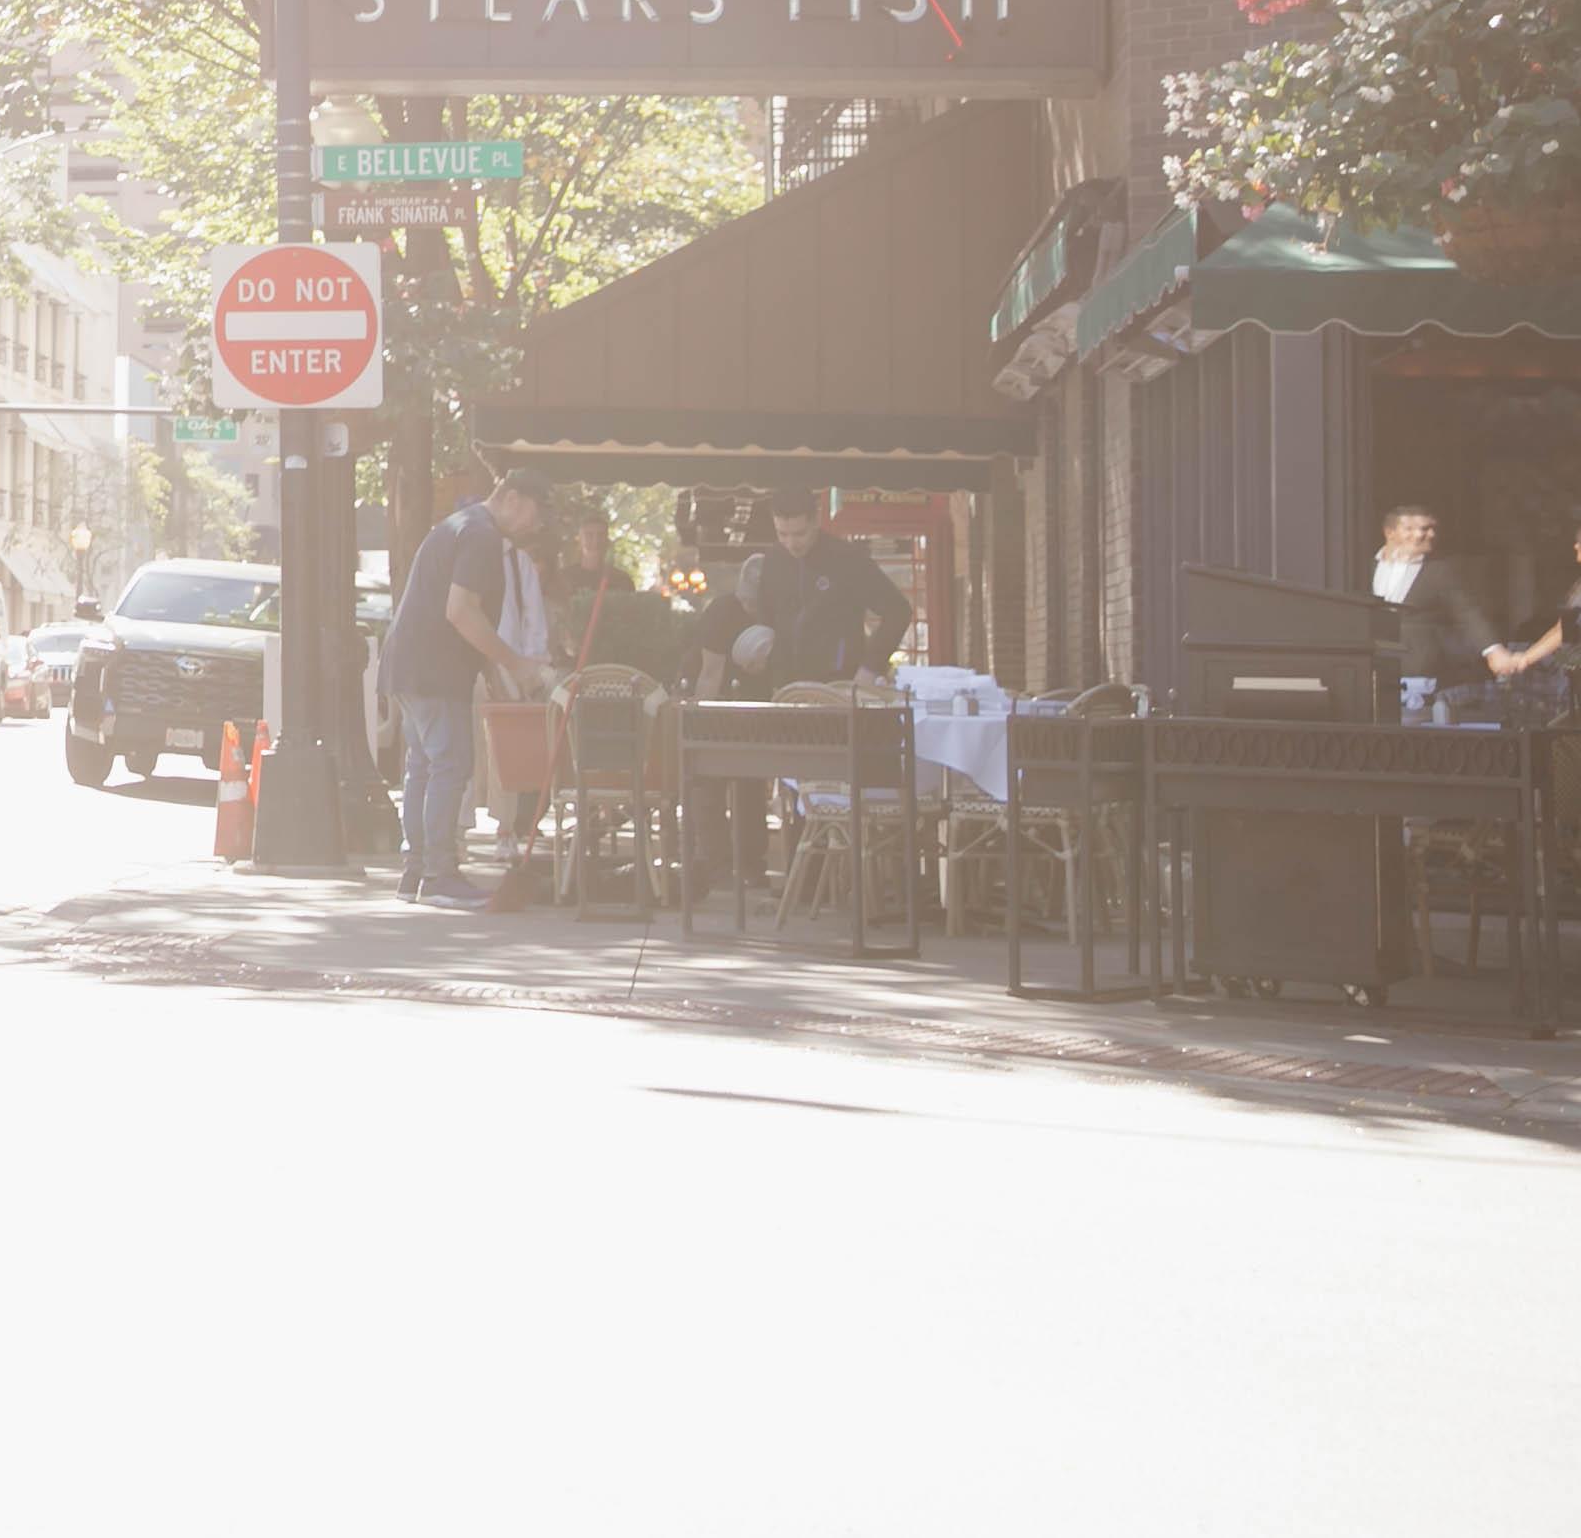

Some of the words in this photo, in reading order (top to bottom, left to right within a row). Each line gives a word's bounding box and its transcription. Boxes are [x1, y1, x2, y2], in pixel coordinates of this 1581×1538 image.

[337, 155, 348, 172] E
[356, 145, 483, 176] BELLEVUE
[374, 196, 429, 207] HONORARY
[337, 206, 385, 225] FRANK
[391, 204, 449, 224] SINATRA
[237, 277, 276, 303] DO
[295, 277, 354, 303] NOT
[250, 349, 342, 374] ENTER
